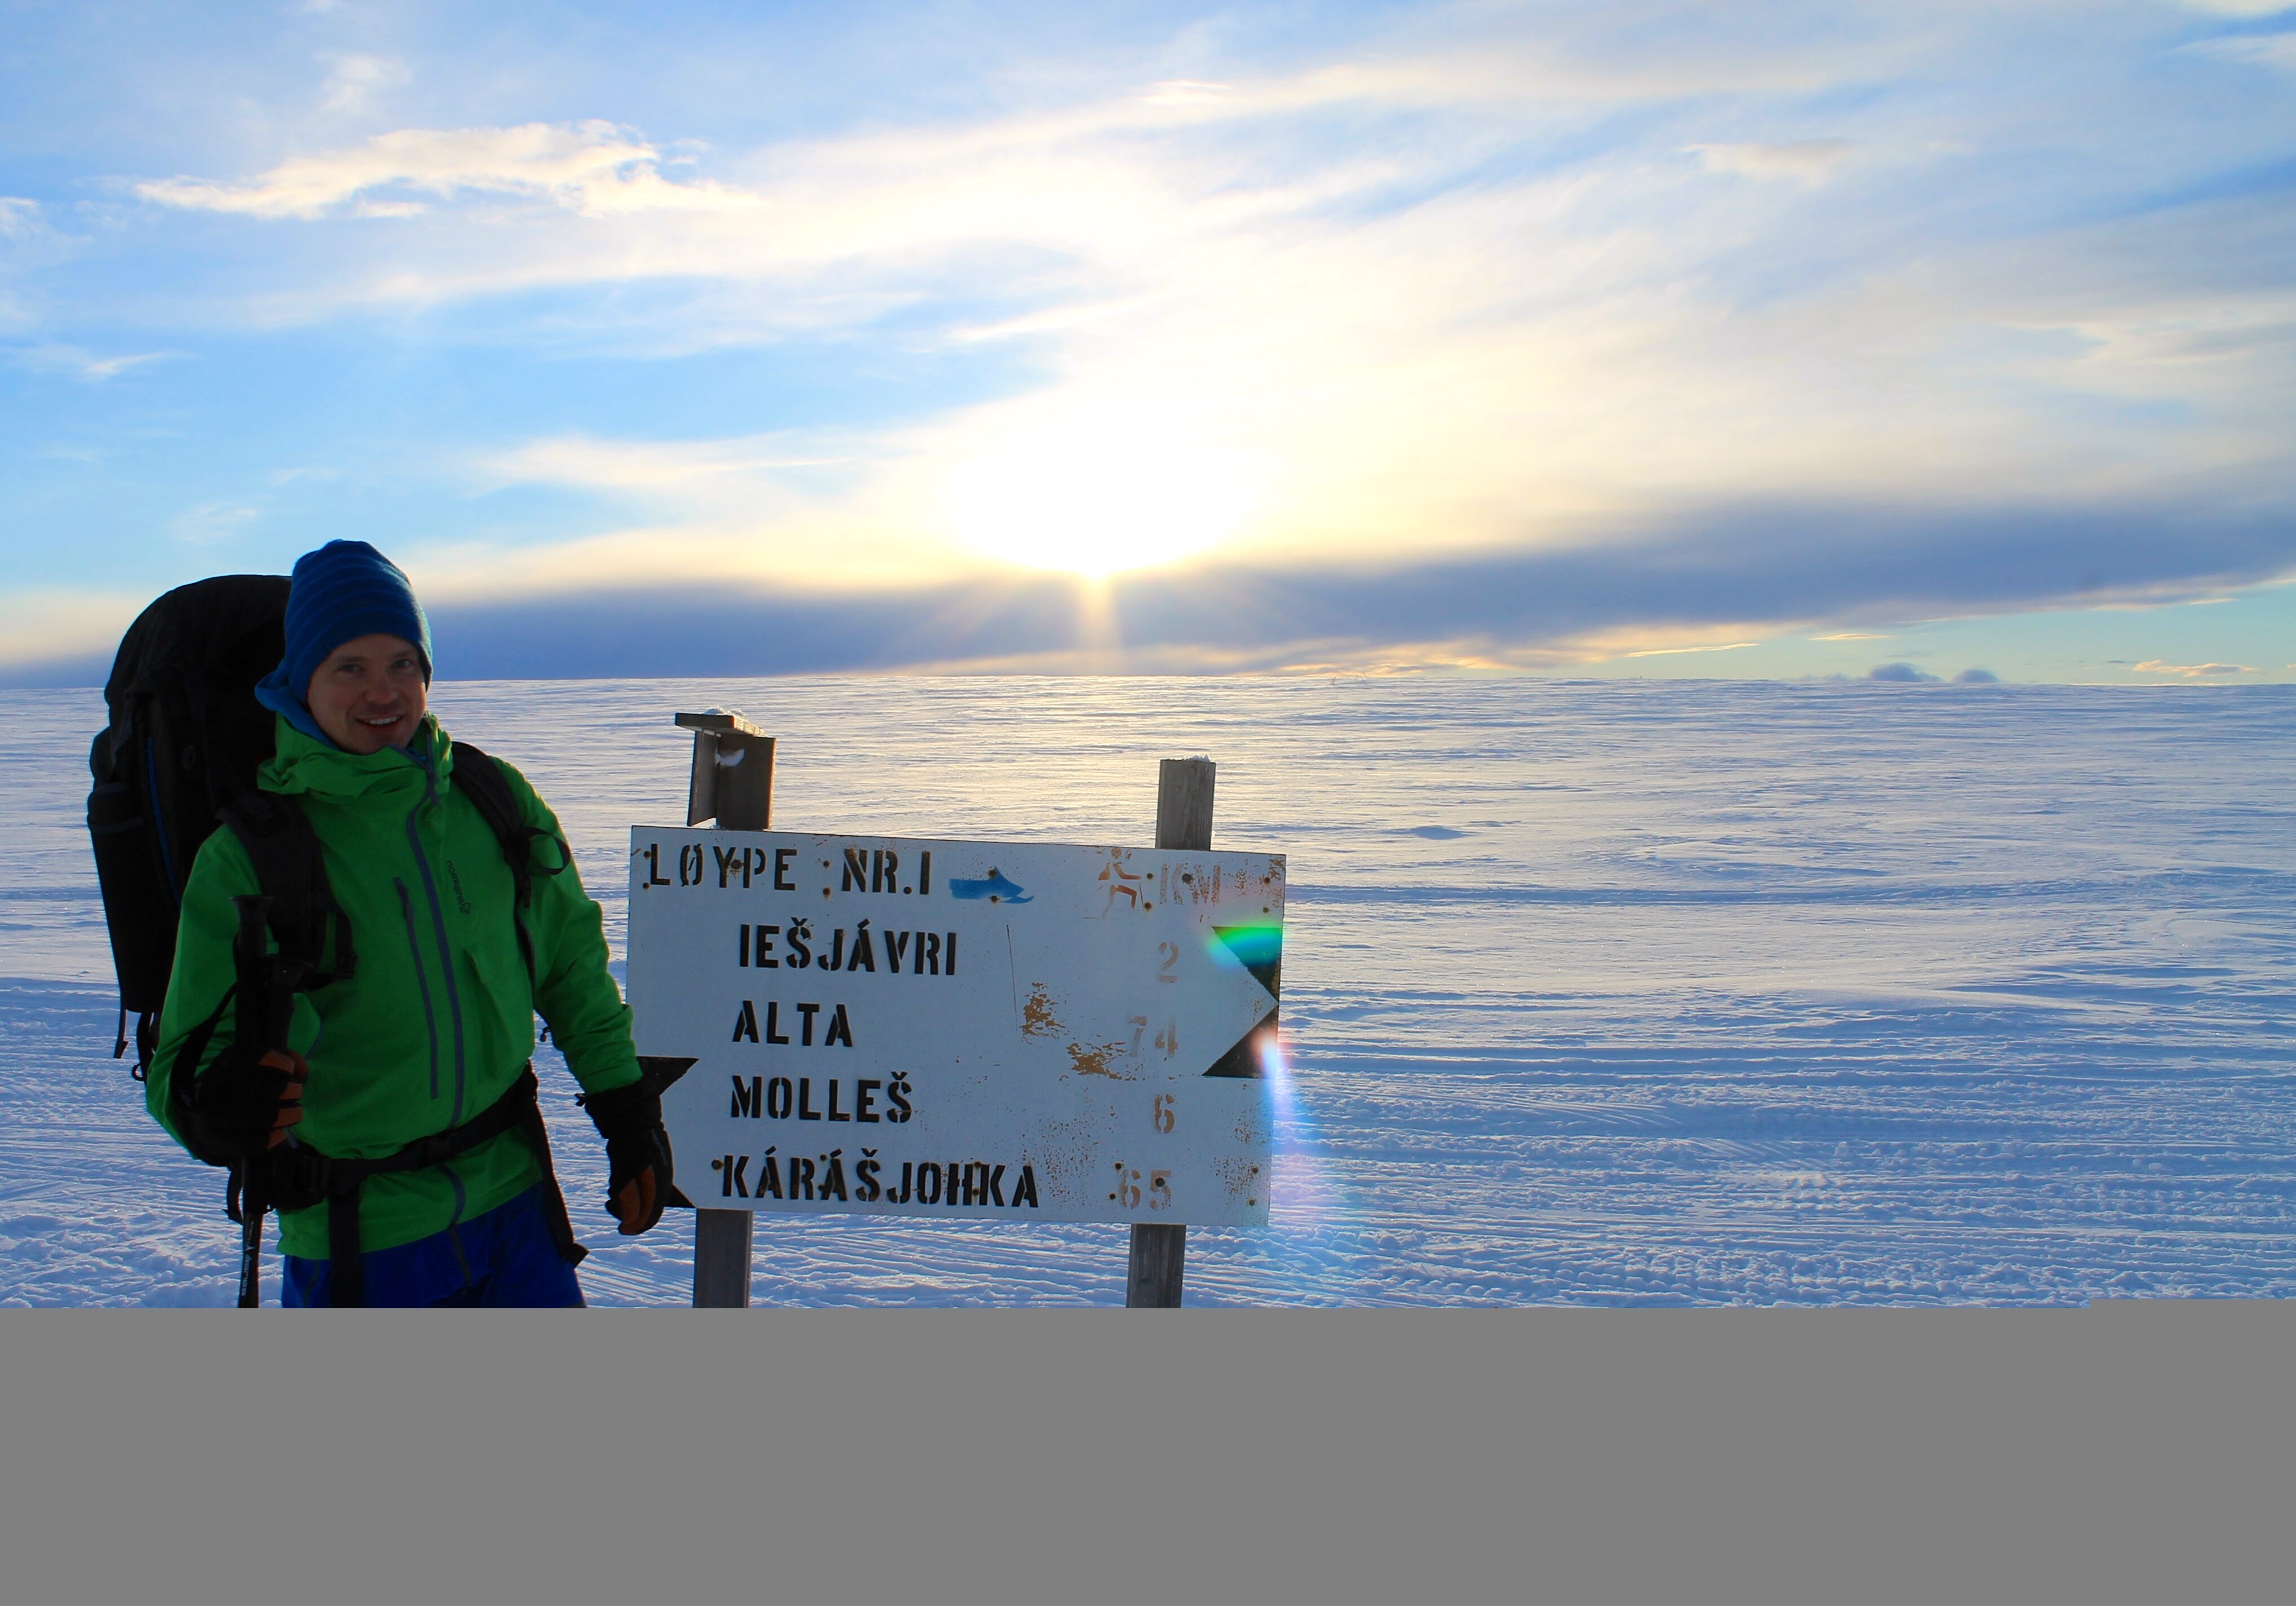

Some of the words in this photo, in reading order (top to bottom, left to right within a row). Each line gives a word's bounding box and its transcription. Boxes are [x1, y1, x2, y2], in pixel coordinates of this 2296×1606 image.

[650, 843, 798, 892] LØYPE
[739, 917, 957, 976] IEŠJÁVRI
[1156, 942, 1180, 983] 2
[732, 1000, 853, 1048] ALTA
[1128, 1016, 1178, 1057] 74
[731, 1071, 912, 1123] MOLLEŠ
[1154, 1094, 1175, 1133] 6
[722, 1145, 1038, 1208] KÁRÁŠJOHKA
[1119, 1170, 1171, 1210] 65
